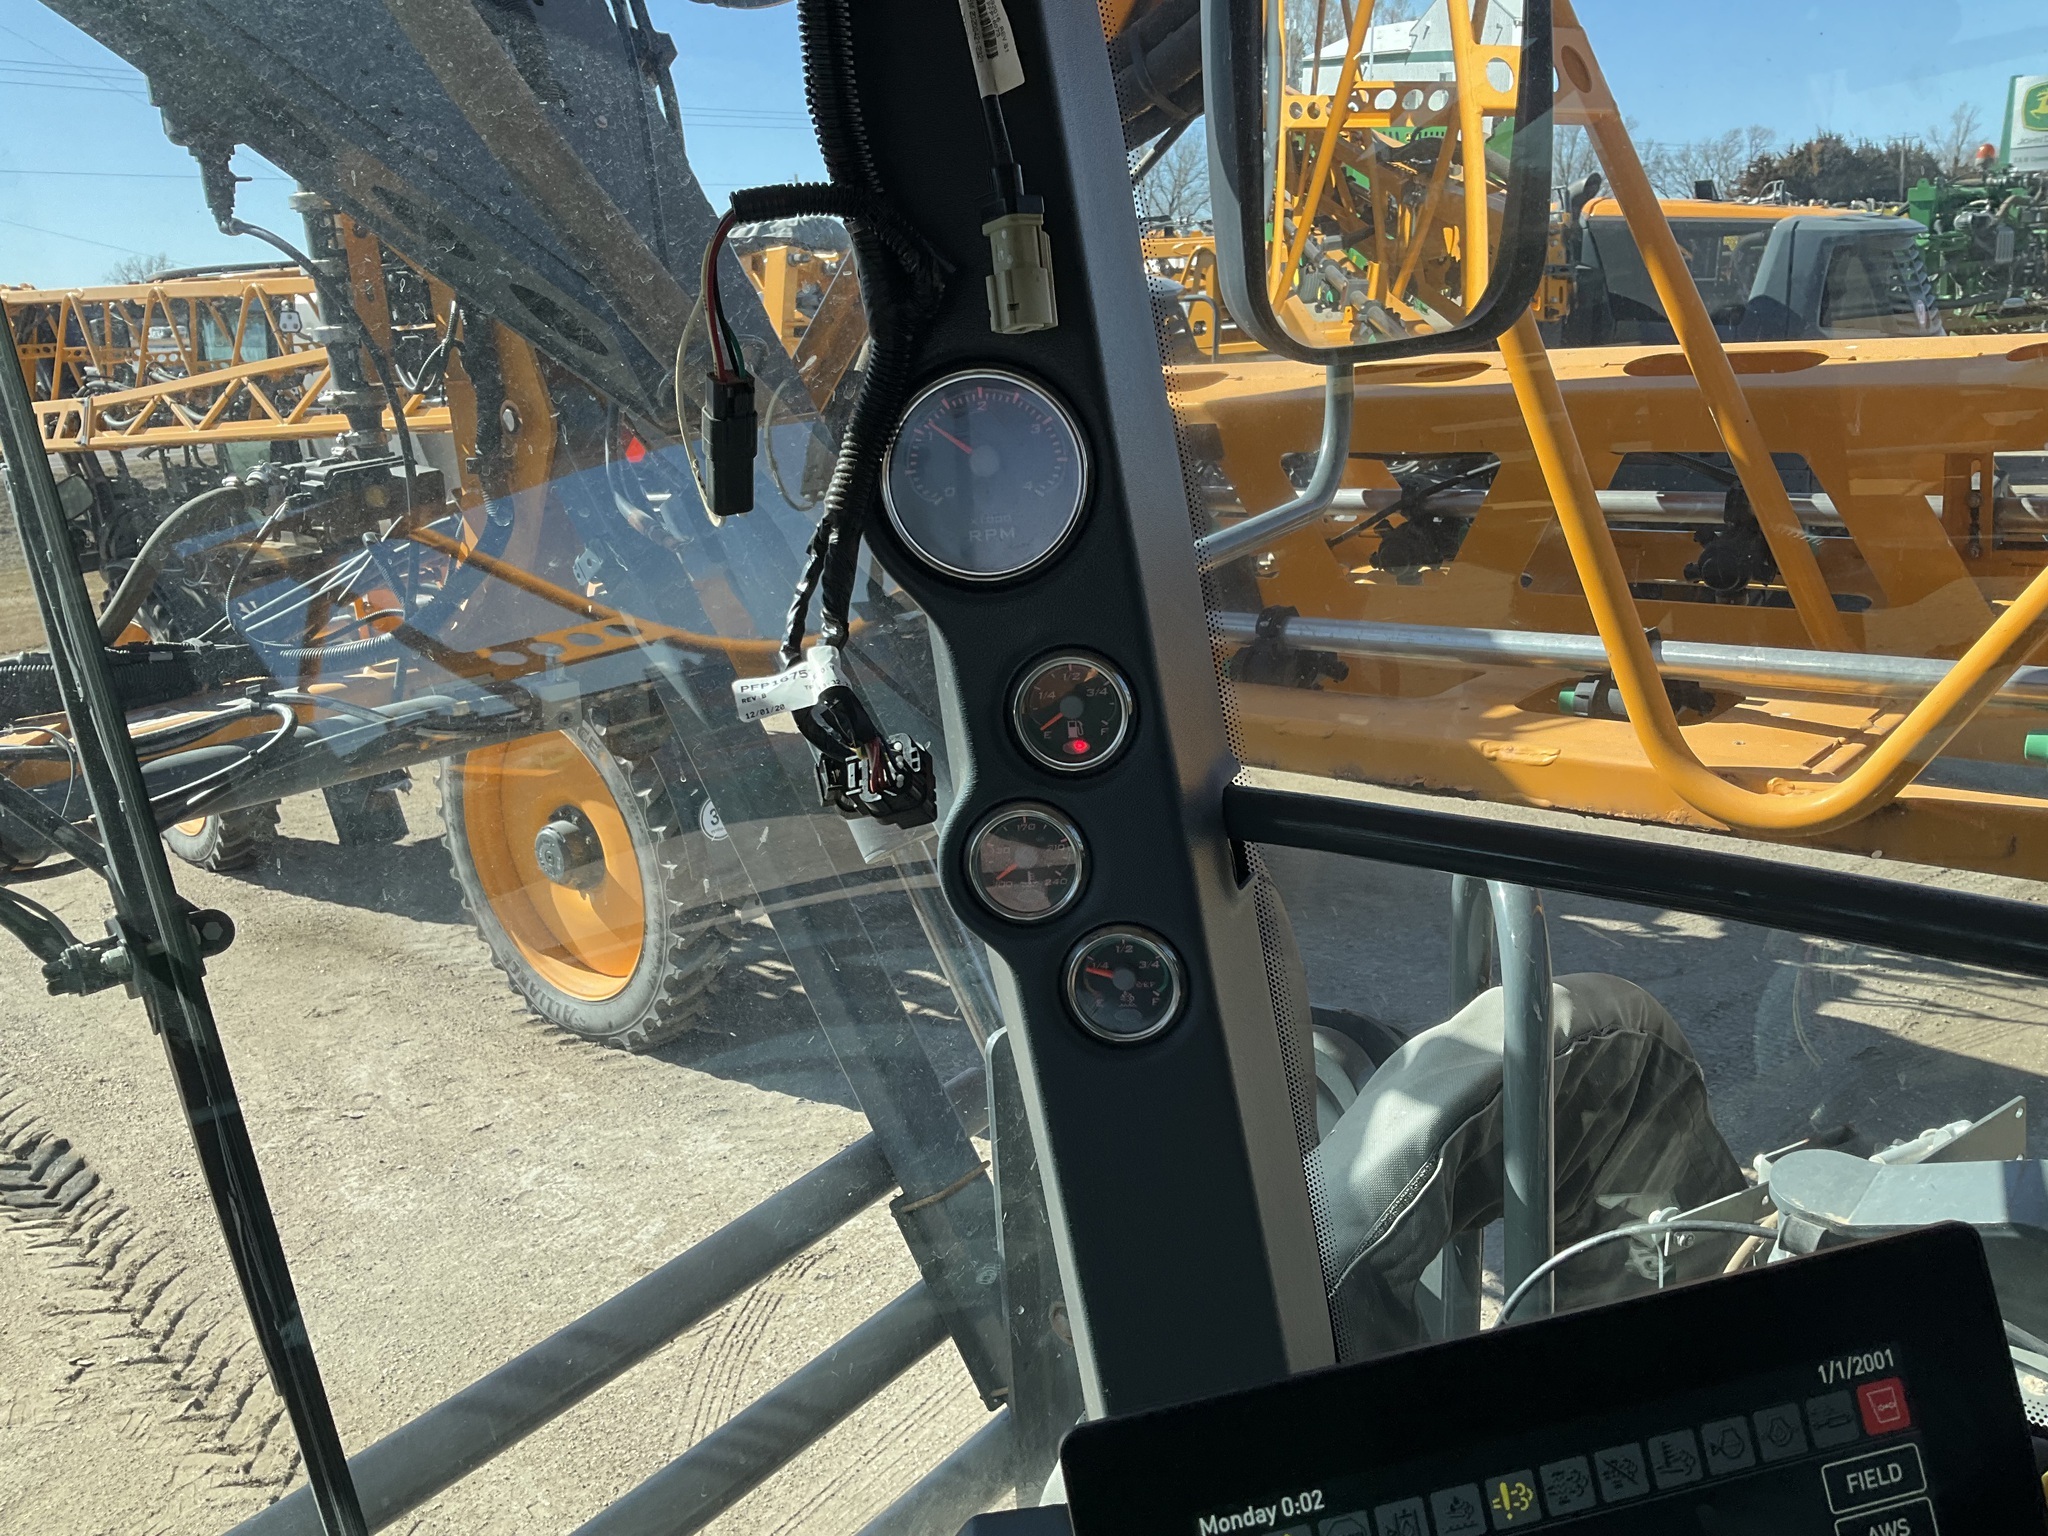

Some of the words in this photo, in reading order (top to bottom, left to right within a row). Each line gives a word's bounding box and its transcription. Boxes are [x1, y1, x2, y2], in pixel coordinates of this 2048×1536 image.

[977, 401, 988, 411] 2
[1030, 424, 1041, 434] 3
[927, 431, 933, 441] 1
[1023, 480, 1033, 491] 4
[945, 487, 956, 497] 0
[969, 527, 1016, 541] RPM
[1063, 672, 1081, 681] 1/2
[1039, 691, 1056, 700] 1/4
[1086, 687, 1108, 697] 3/4
[741, 696, 757, 704] REV
[745, 703, 786, 720] 12/01/20
[1043, 731, 1052, 739] E
[1101, 728, 1109, 736] F
[1017, 823, 1036, 831] 170
[1044, 878, 1068, 886] 240
[1115, 945, 1133, 953] 1/2
[1139, 960, 1160, 969] 3/4
[501, 951, 578, 1024] ALLIANCE
[1151, 997, 1159, 1006] F
[1818, 1348, 1894, 1384] 1/1/2001
[1846, 1463, 1903, 1493] FIELD
[1199, 1505, 1276, 1536] Monday
[1281, 1489, 1325, 1517] 0:02
